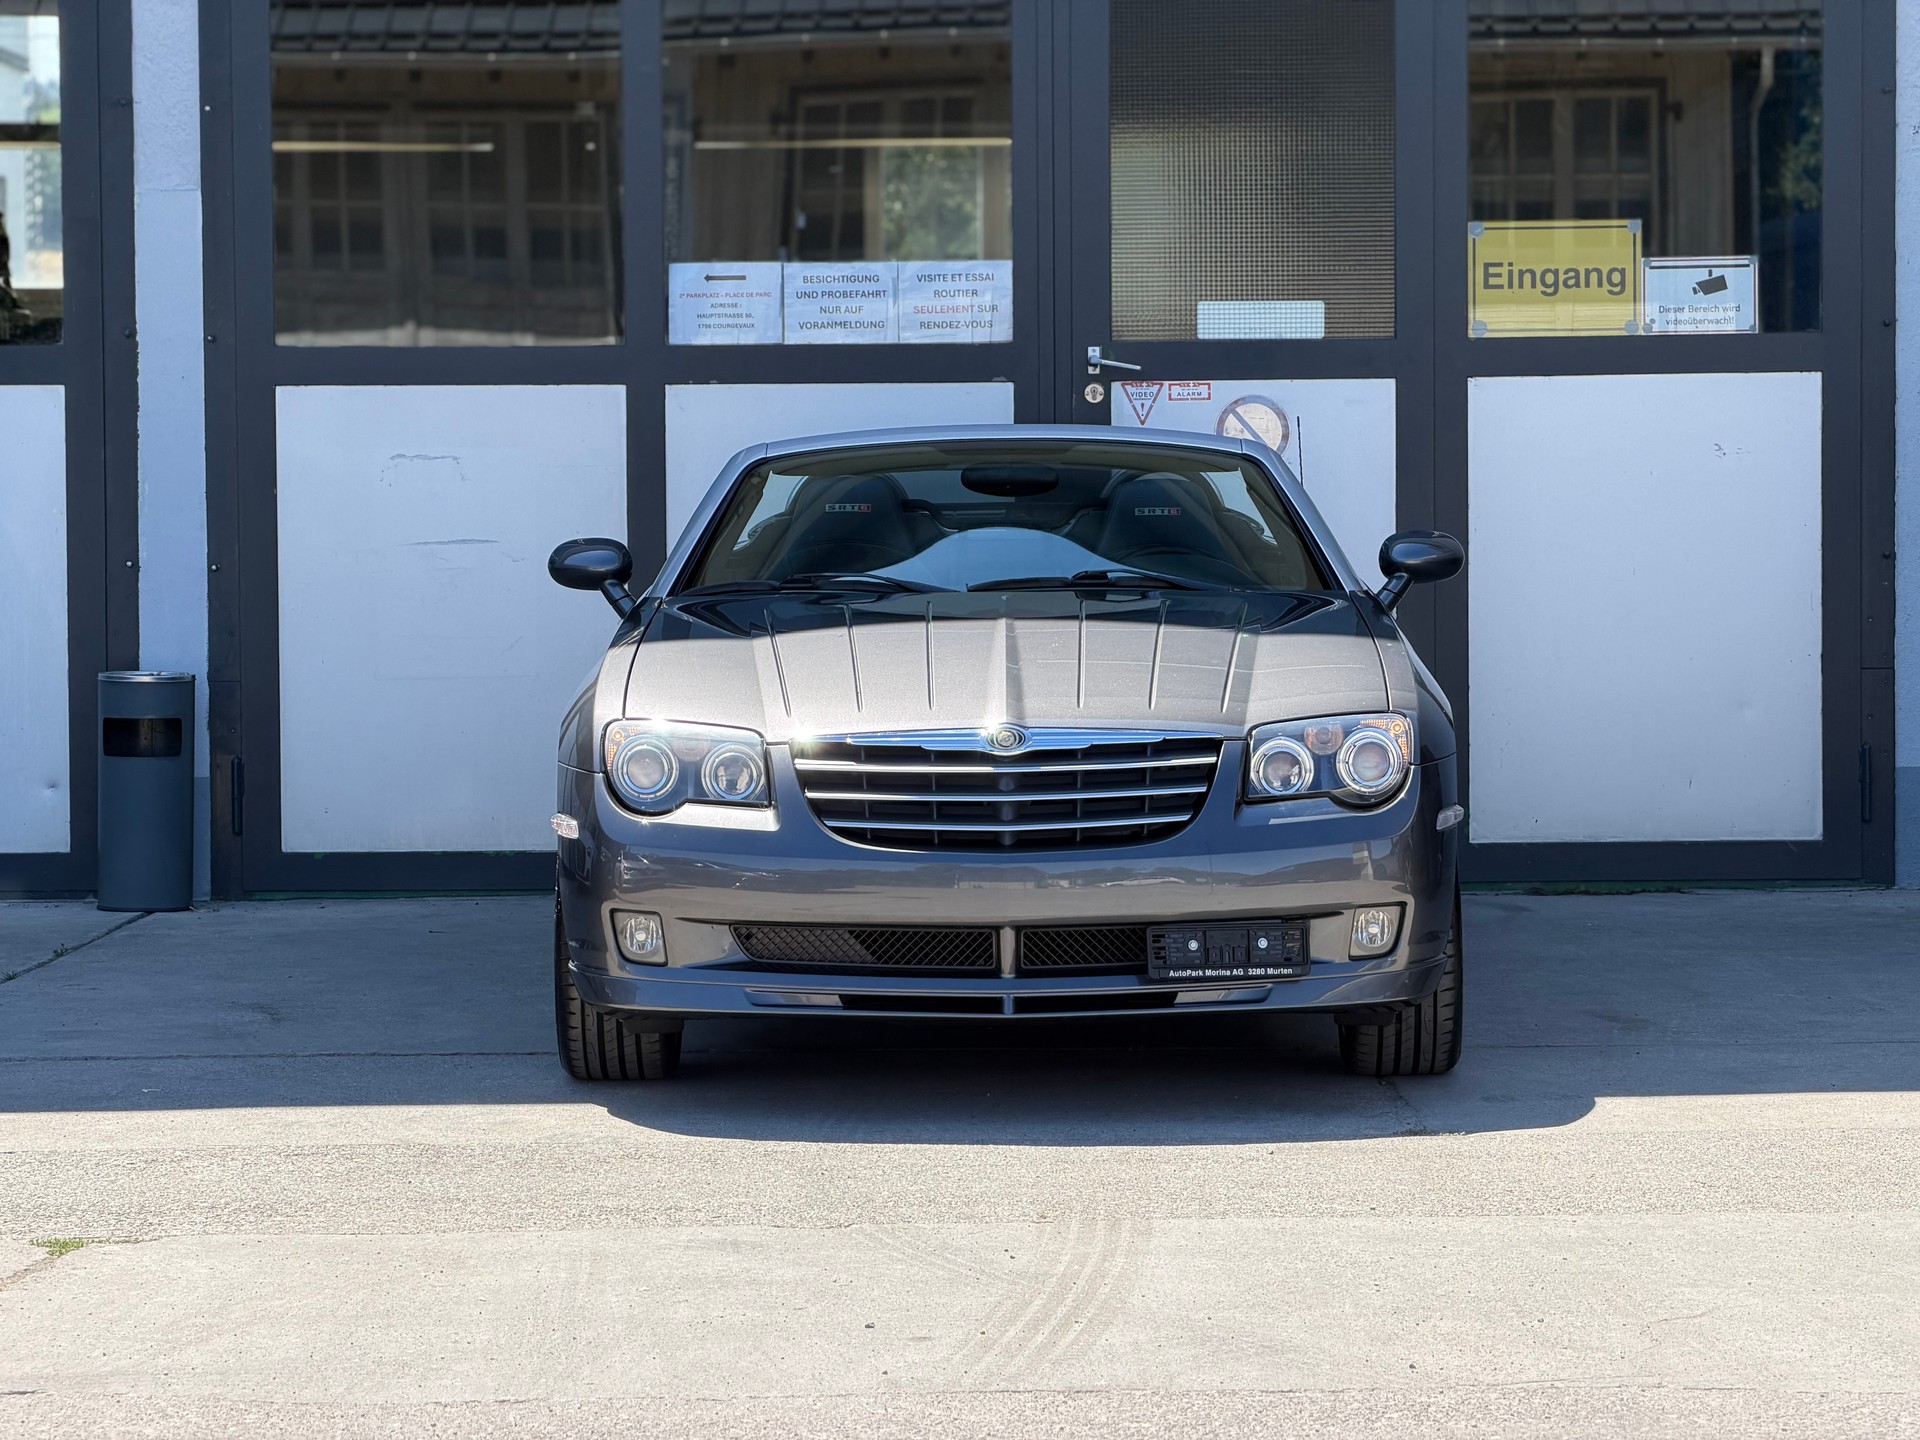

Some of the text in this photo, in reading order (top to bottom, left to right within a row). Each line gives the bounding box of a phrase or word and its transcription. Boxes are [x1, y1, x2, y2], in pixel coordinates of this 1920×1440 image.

[803, 274, 880, 284] BESICHTIGUNG
[916, 273, 994, 283] VISITE ET ESSAI
[1482, 262, 1627, 297] Eingang
[796, 290, 887, 299] UND PROBEFAHRT
[933, 289, 978, 298] ROUTIER
[819, 305, 864, 314] NUR AUF
[913, 304, 999, 314] SEULEMENT SUR
[1658, 304, 1741, 314] Dieser Bereich wird
[798, 320, 885, 330] VORANMELDUNG
[919, 320, 993, 330] RENDEZ-VOUS
[1168, 969, 1204, 978] AutoPark
[1232, 968, 1244, 976] AG
[1266, 967, 1293, 975] Murten
